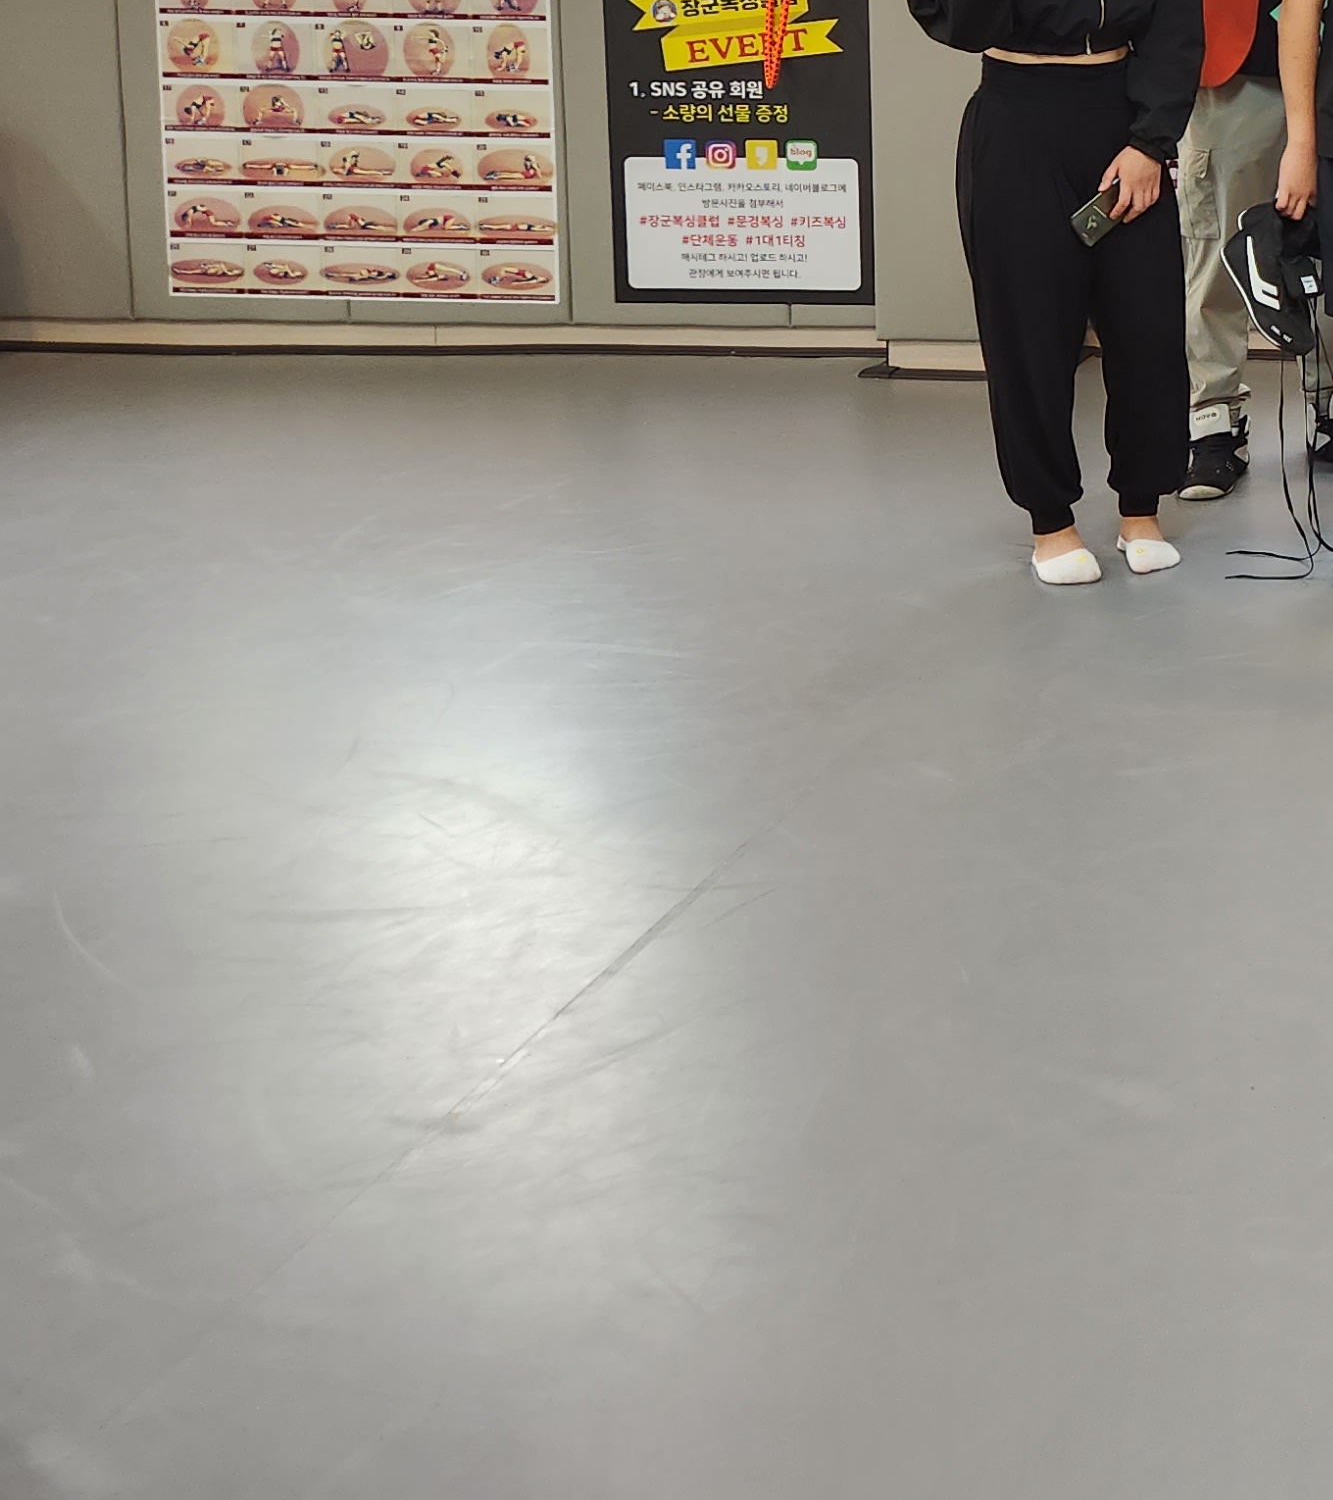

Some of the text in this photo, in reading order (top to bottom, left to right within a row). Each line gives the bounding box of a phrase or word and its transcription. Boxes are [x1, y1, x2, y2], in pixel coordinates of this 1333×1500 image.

[629, 81, 763, 99] 1. SNS 공유 회원
[662, 104, 713, 122] 소량의
[718, 104, 750, 123] 선물
[756, 104, 789, 123] 증정
[790, 147, 812, 157] blog
[791, 216, 846, 229] #키즈복싱
[682, 234, 805, 247] #단체운동 #1대1티칭
